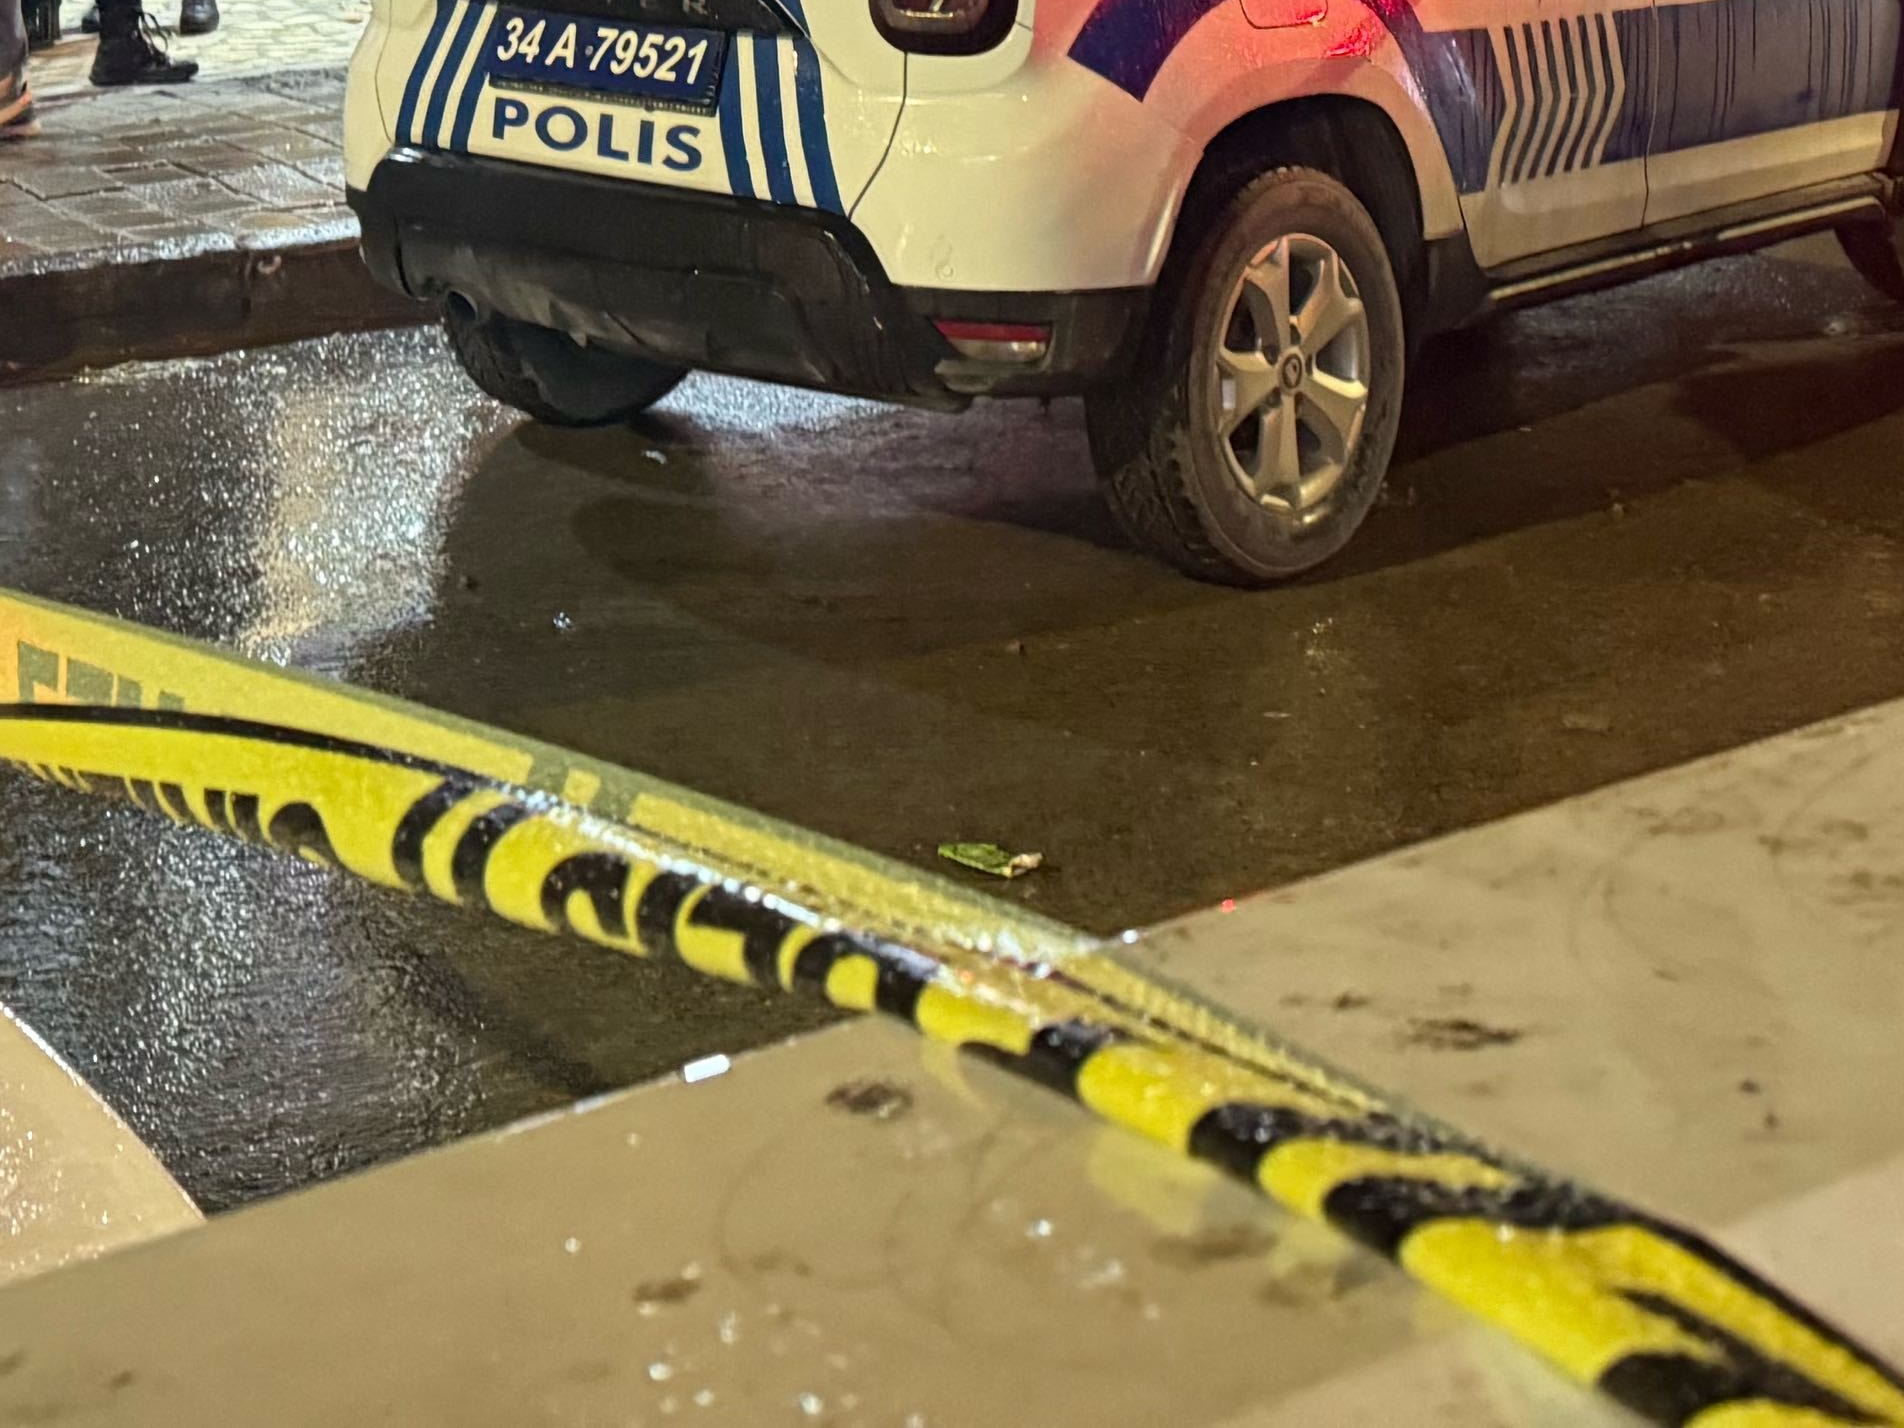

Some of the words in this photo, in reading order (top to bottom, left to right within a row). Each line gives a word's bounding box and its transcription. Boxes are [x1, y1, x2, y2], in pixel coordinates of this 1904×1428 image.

[497, 17, 546, 64] 34
[545, 23, 577, 69] A
[588, 26, 708, 85] 79521
